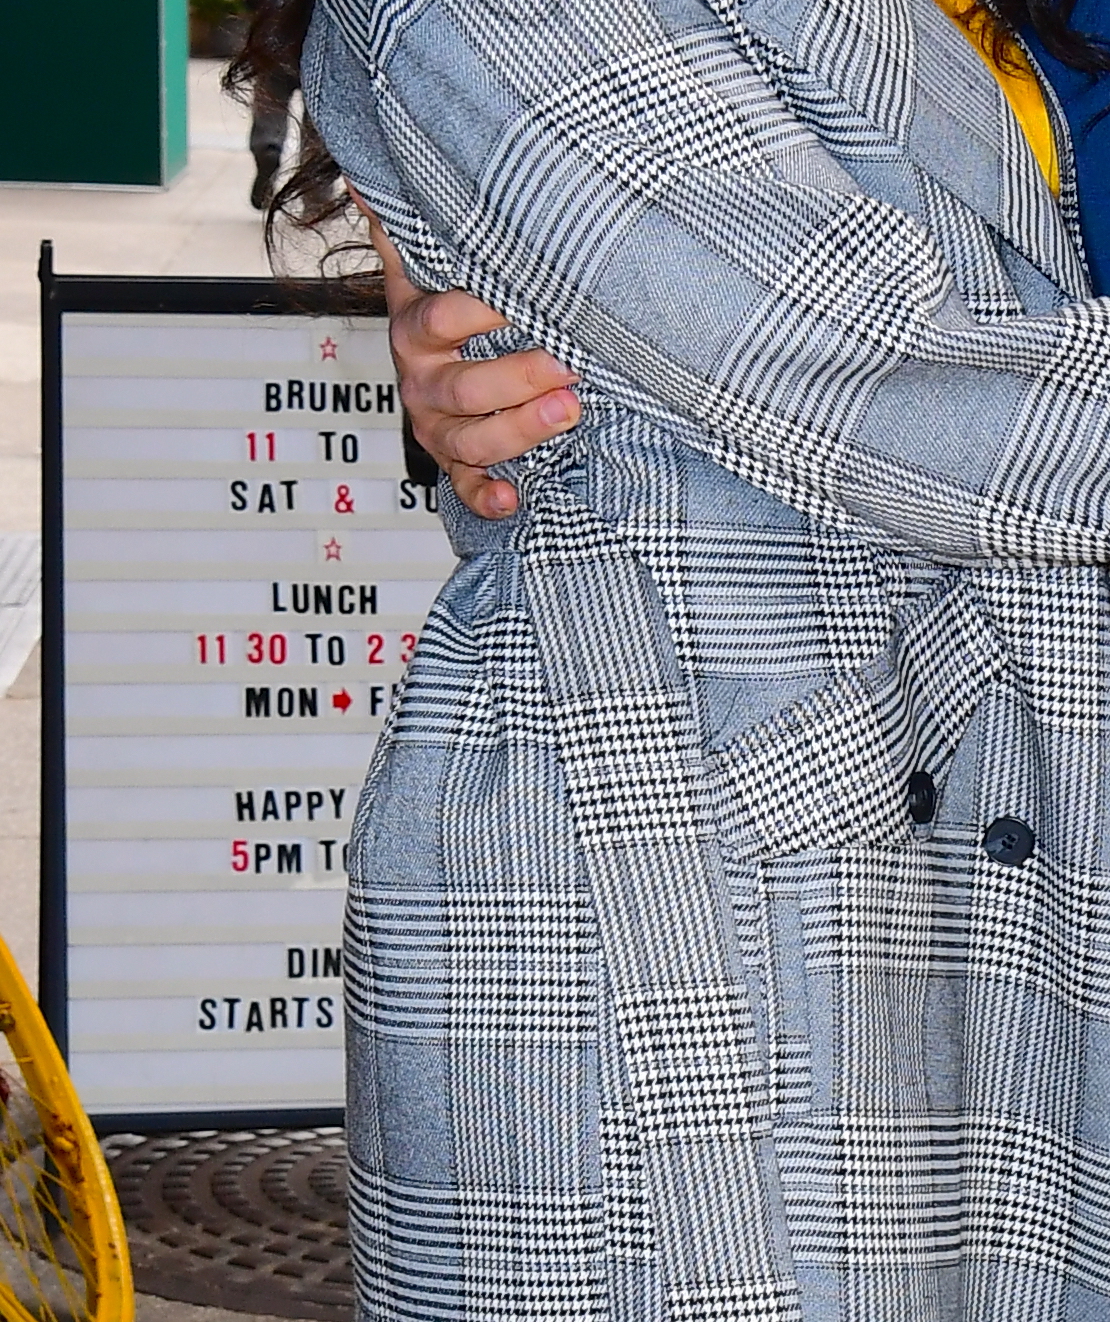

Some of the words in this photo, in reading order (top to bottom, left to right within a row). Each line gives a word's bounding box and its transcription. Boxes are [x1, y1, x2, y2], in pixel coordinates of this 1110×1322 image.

[265, 379, 395, 414] BRUNCH
[246, 432, 275, 462] 11
[319, 431, 359, 464] TO
[230, 480, 298, 514] SAT
[334, 484, 354, 514] &
[272, 581, 377, 615] LUNCH
[198, 634, 226, 664] 11
[247, 633, 287, 665] 30
[305, 633, 345, 666] TO
[245, 687, 318, 718] MON
[235, 788, 346, 822] HAPPY
[231, 840, 302, 874] 5PM
[198, 997, 334, 1033] STARTS
